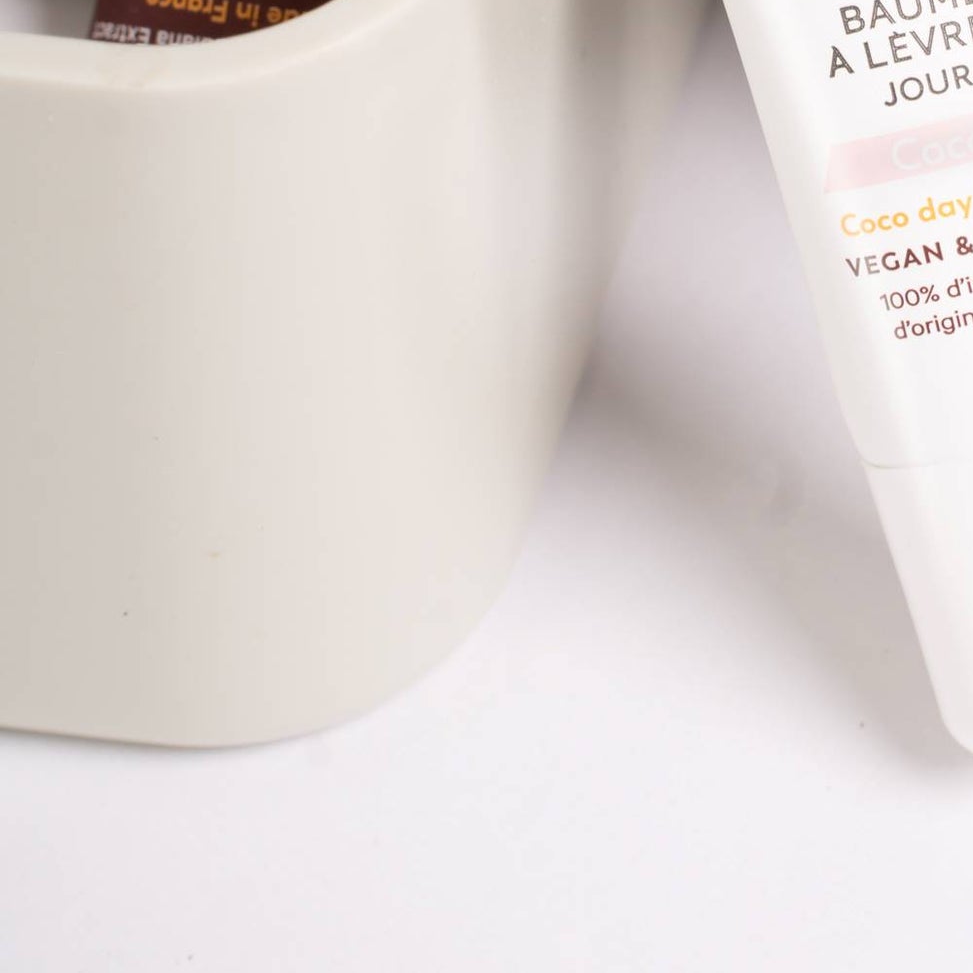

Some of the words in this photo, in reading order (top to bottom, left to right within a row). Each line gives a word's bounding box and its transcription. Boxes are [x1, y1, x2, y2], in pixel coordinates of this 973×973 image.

[235, 3, 260, 26] in
[829, 46, 853, 78] A
[840, 212, 909, 237] Coco
[918, 197, 973, 226] day
[845, 242, 944, 277] VEGAN
[956, 236, 973, 256] &
[880, 285, 940, 311] 100%
